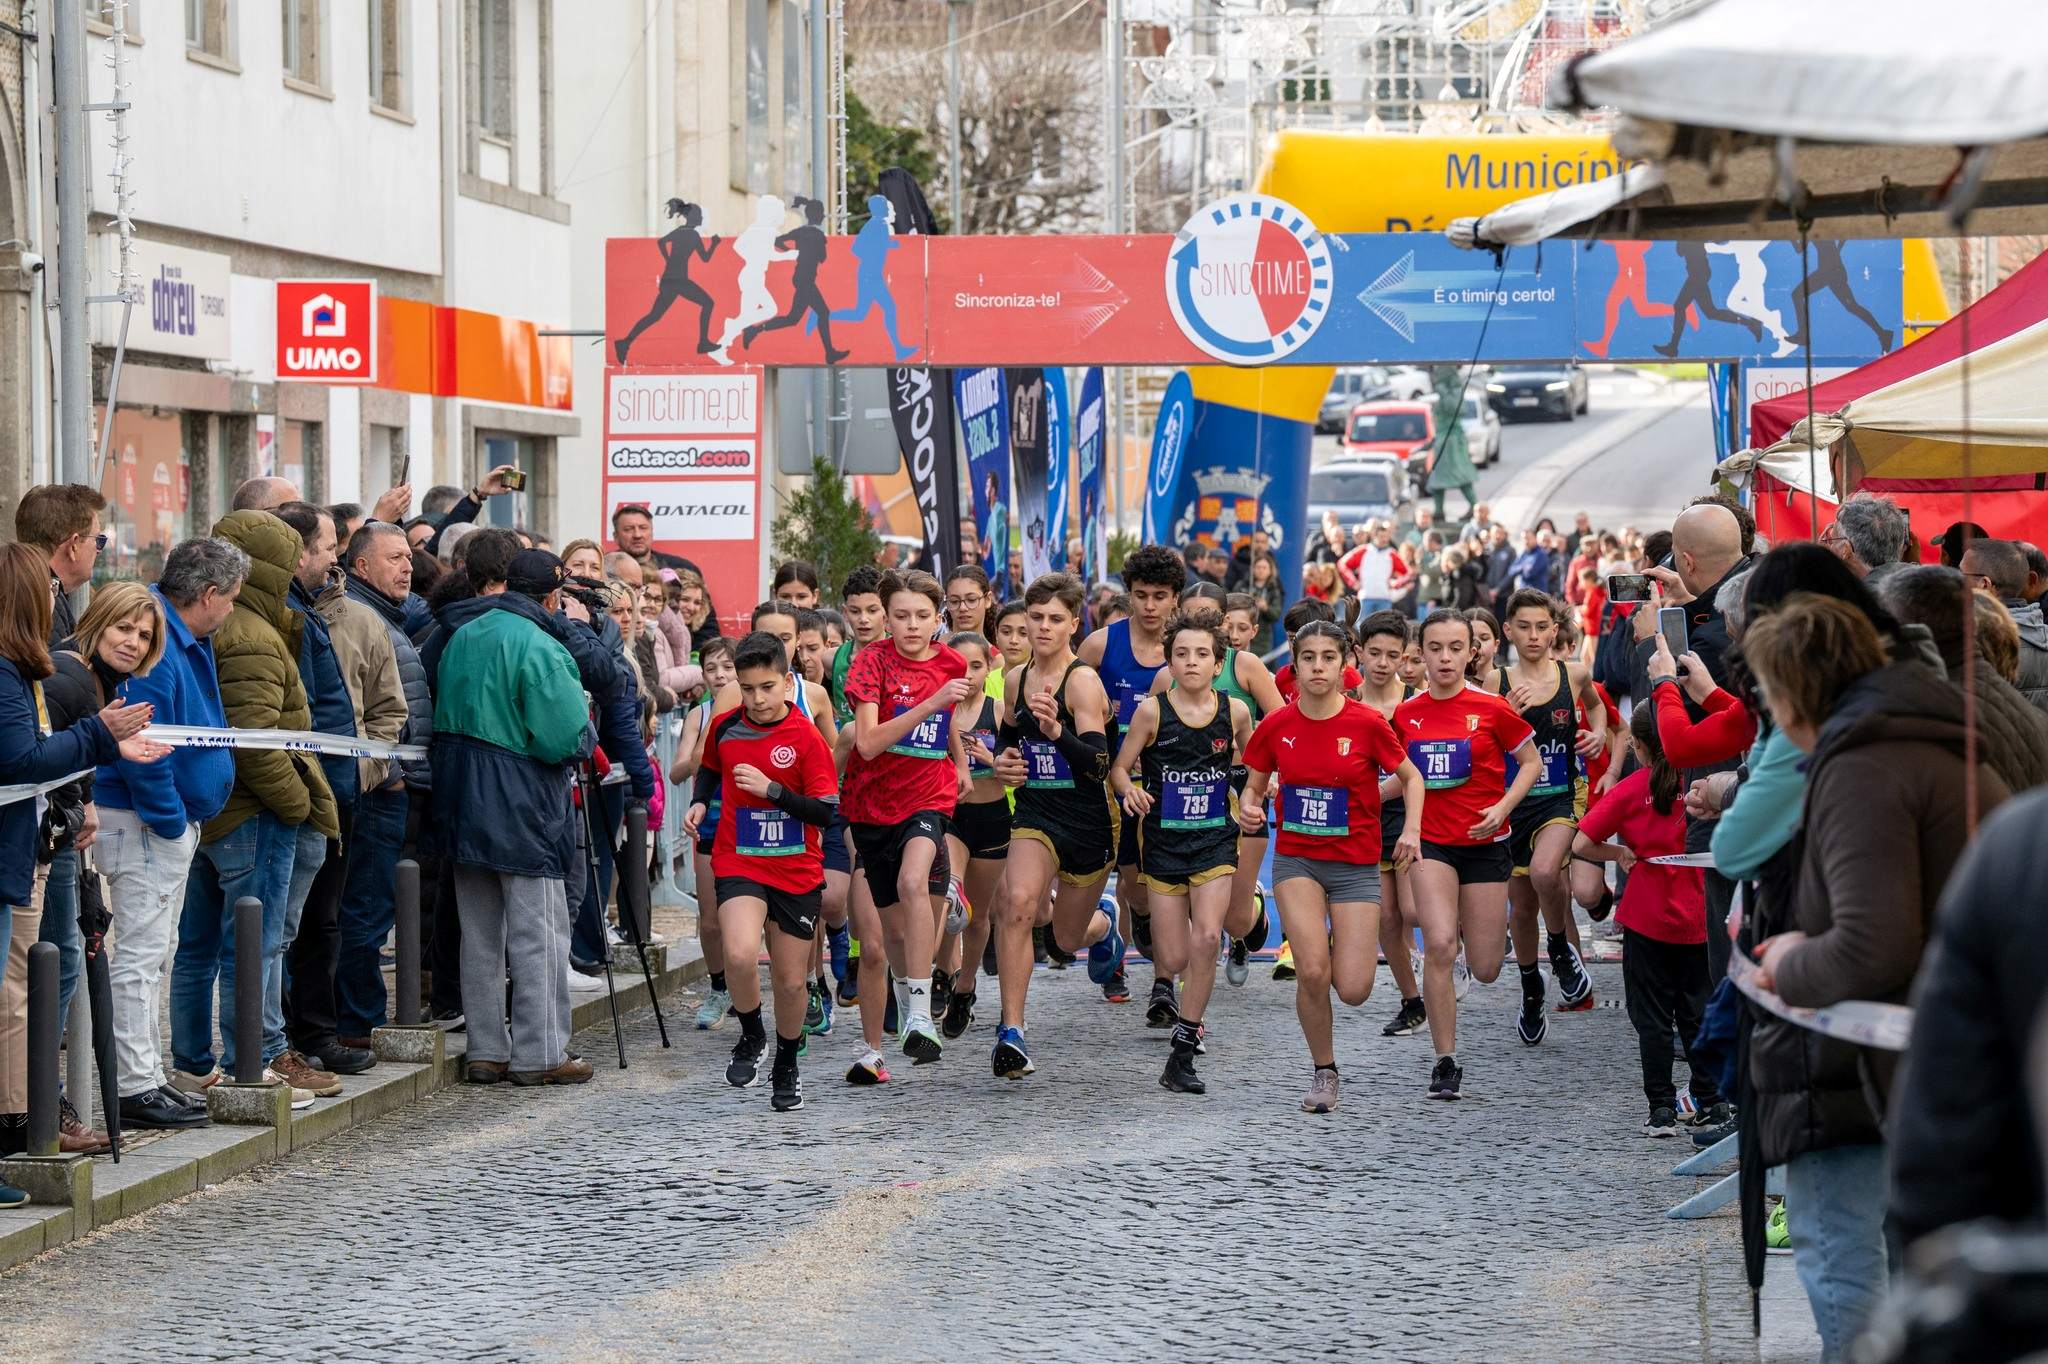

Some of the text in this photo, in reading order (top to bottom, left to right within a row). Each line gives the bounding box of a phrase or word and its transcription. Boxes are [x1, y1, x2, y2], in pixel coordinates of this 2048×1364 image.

[152, 263, 195, 336] abreu
[955, 291, 1061, 308] Sincroniza-te!
[1434, 285, 1556, 306] É o timing certo!
[286, 347, 362, 371] UIMO
[617, 381, 750, 428] sinctime.pt
[613, 448, 750, 468] datacol.com
[654, 505, 750, 516] DATACOL
[911, 722, 938, 743] 745
[1035, 755, 1056, 774] 732
[1427, 753, 1450, 774] 751
[1183, 795, 1209, 814] 733
[1301, 799, 1328, 820] 752
[759, 821, 784, 841] 701
